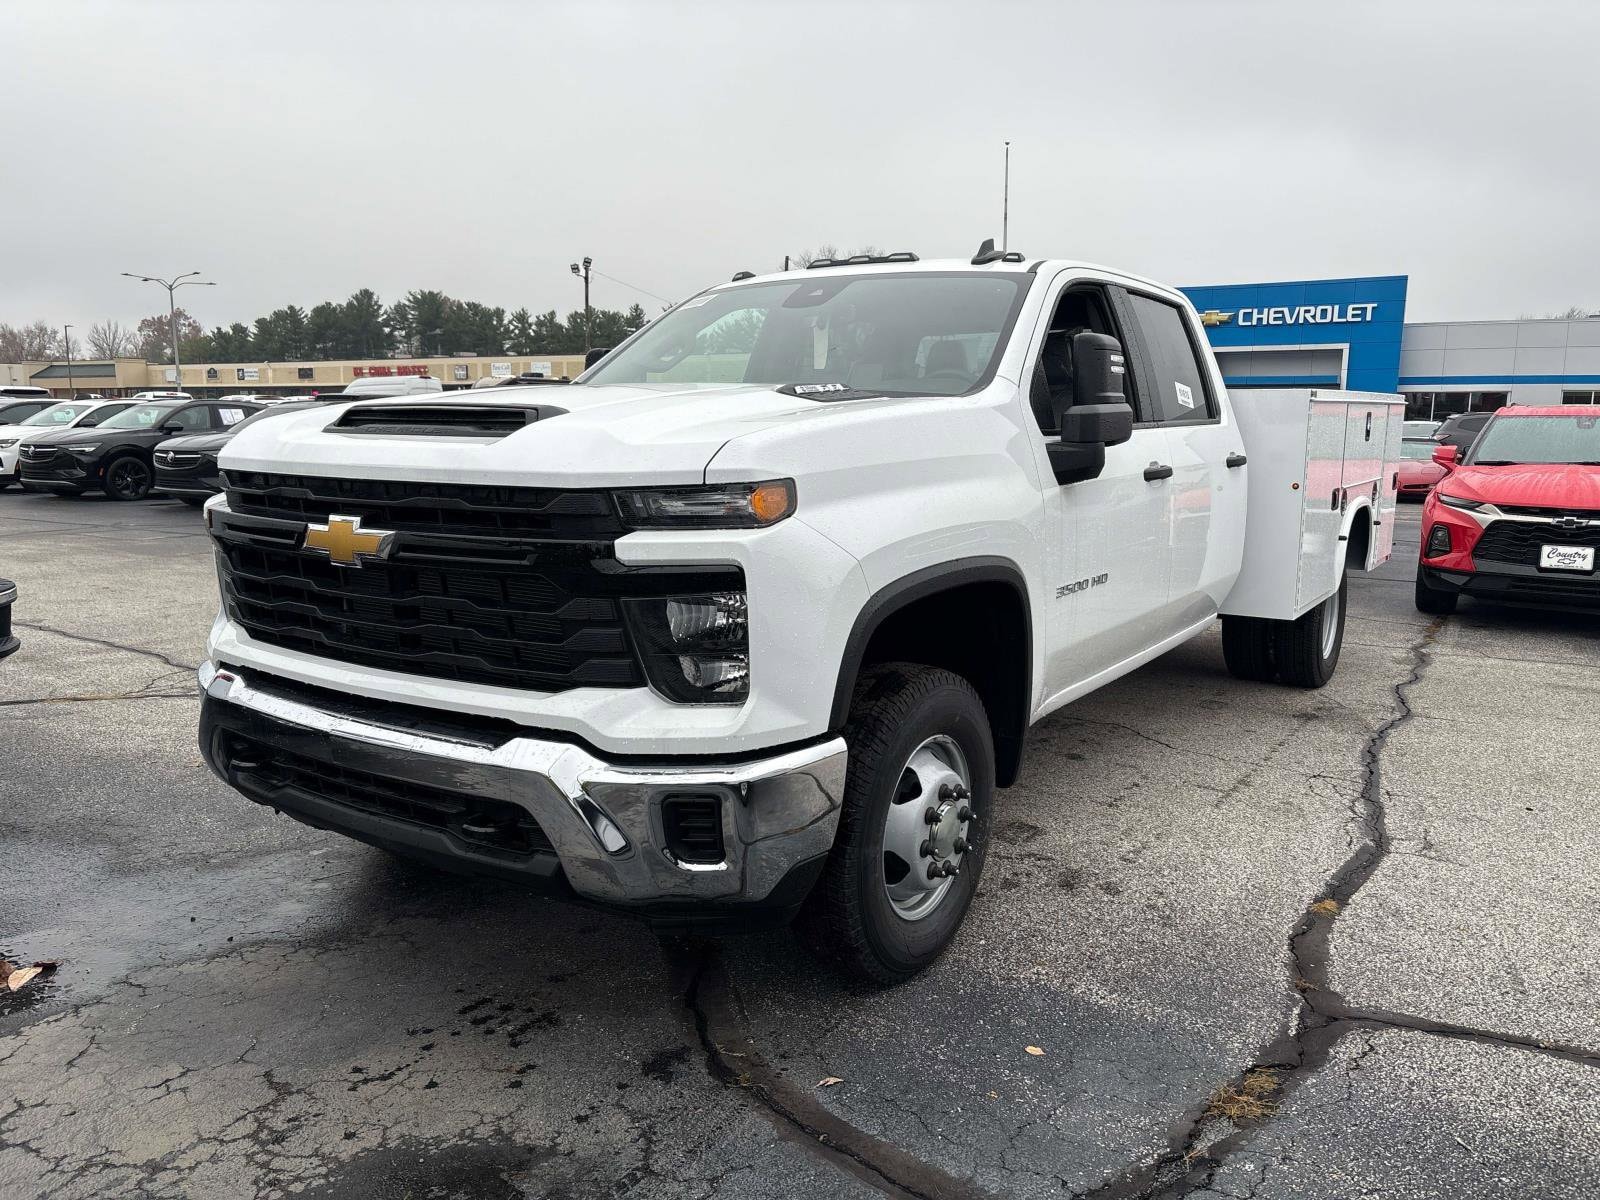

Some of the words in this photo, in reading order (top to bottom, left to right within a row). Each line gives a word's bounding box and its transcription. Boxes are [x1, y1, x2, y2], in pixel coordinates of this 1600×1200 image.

[1238, 303, 1378, 326] CHEVROLET
[1547, 547, 1588, 562] Country
[1055, 578, 1089, 600] 3500
[1091, 572, 1109, 588] HD
